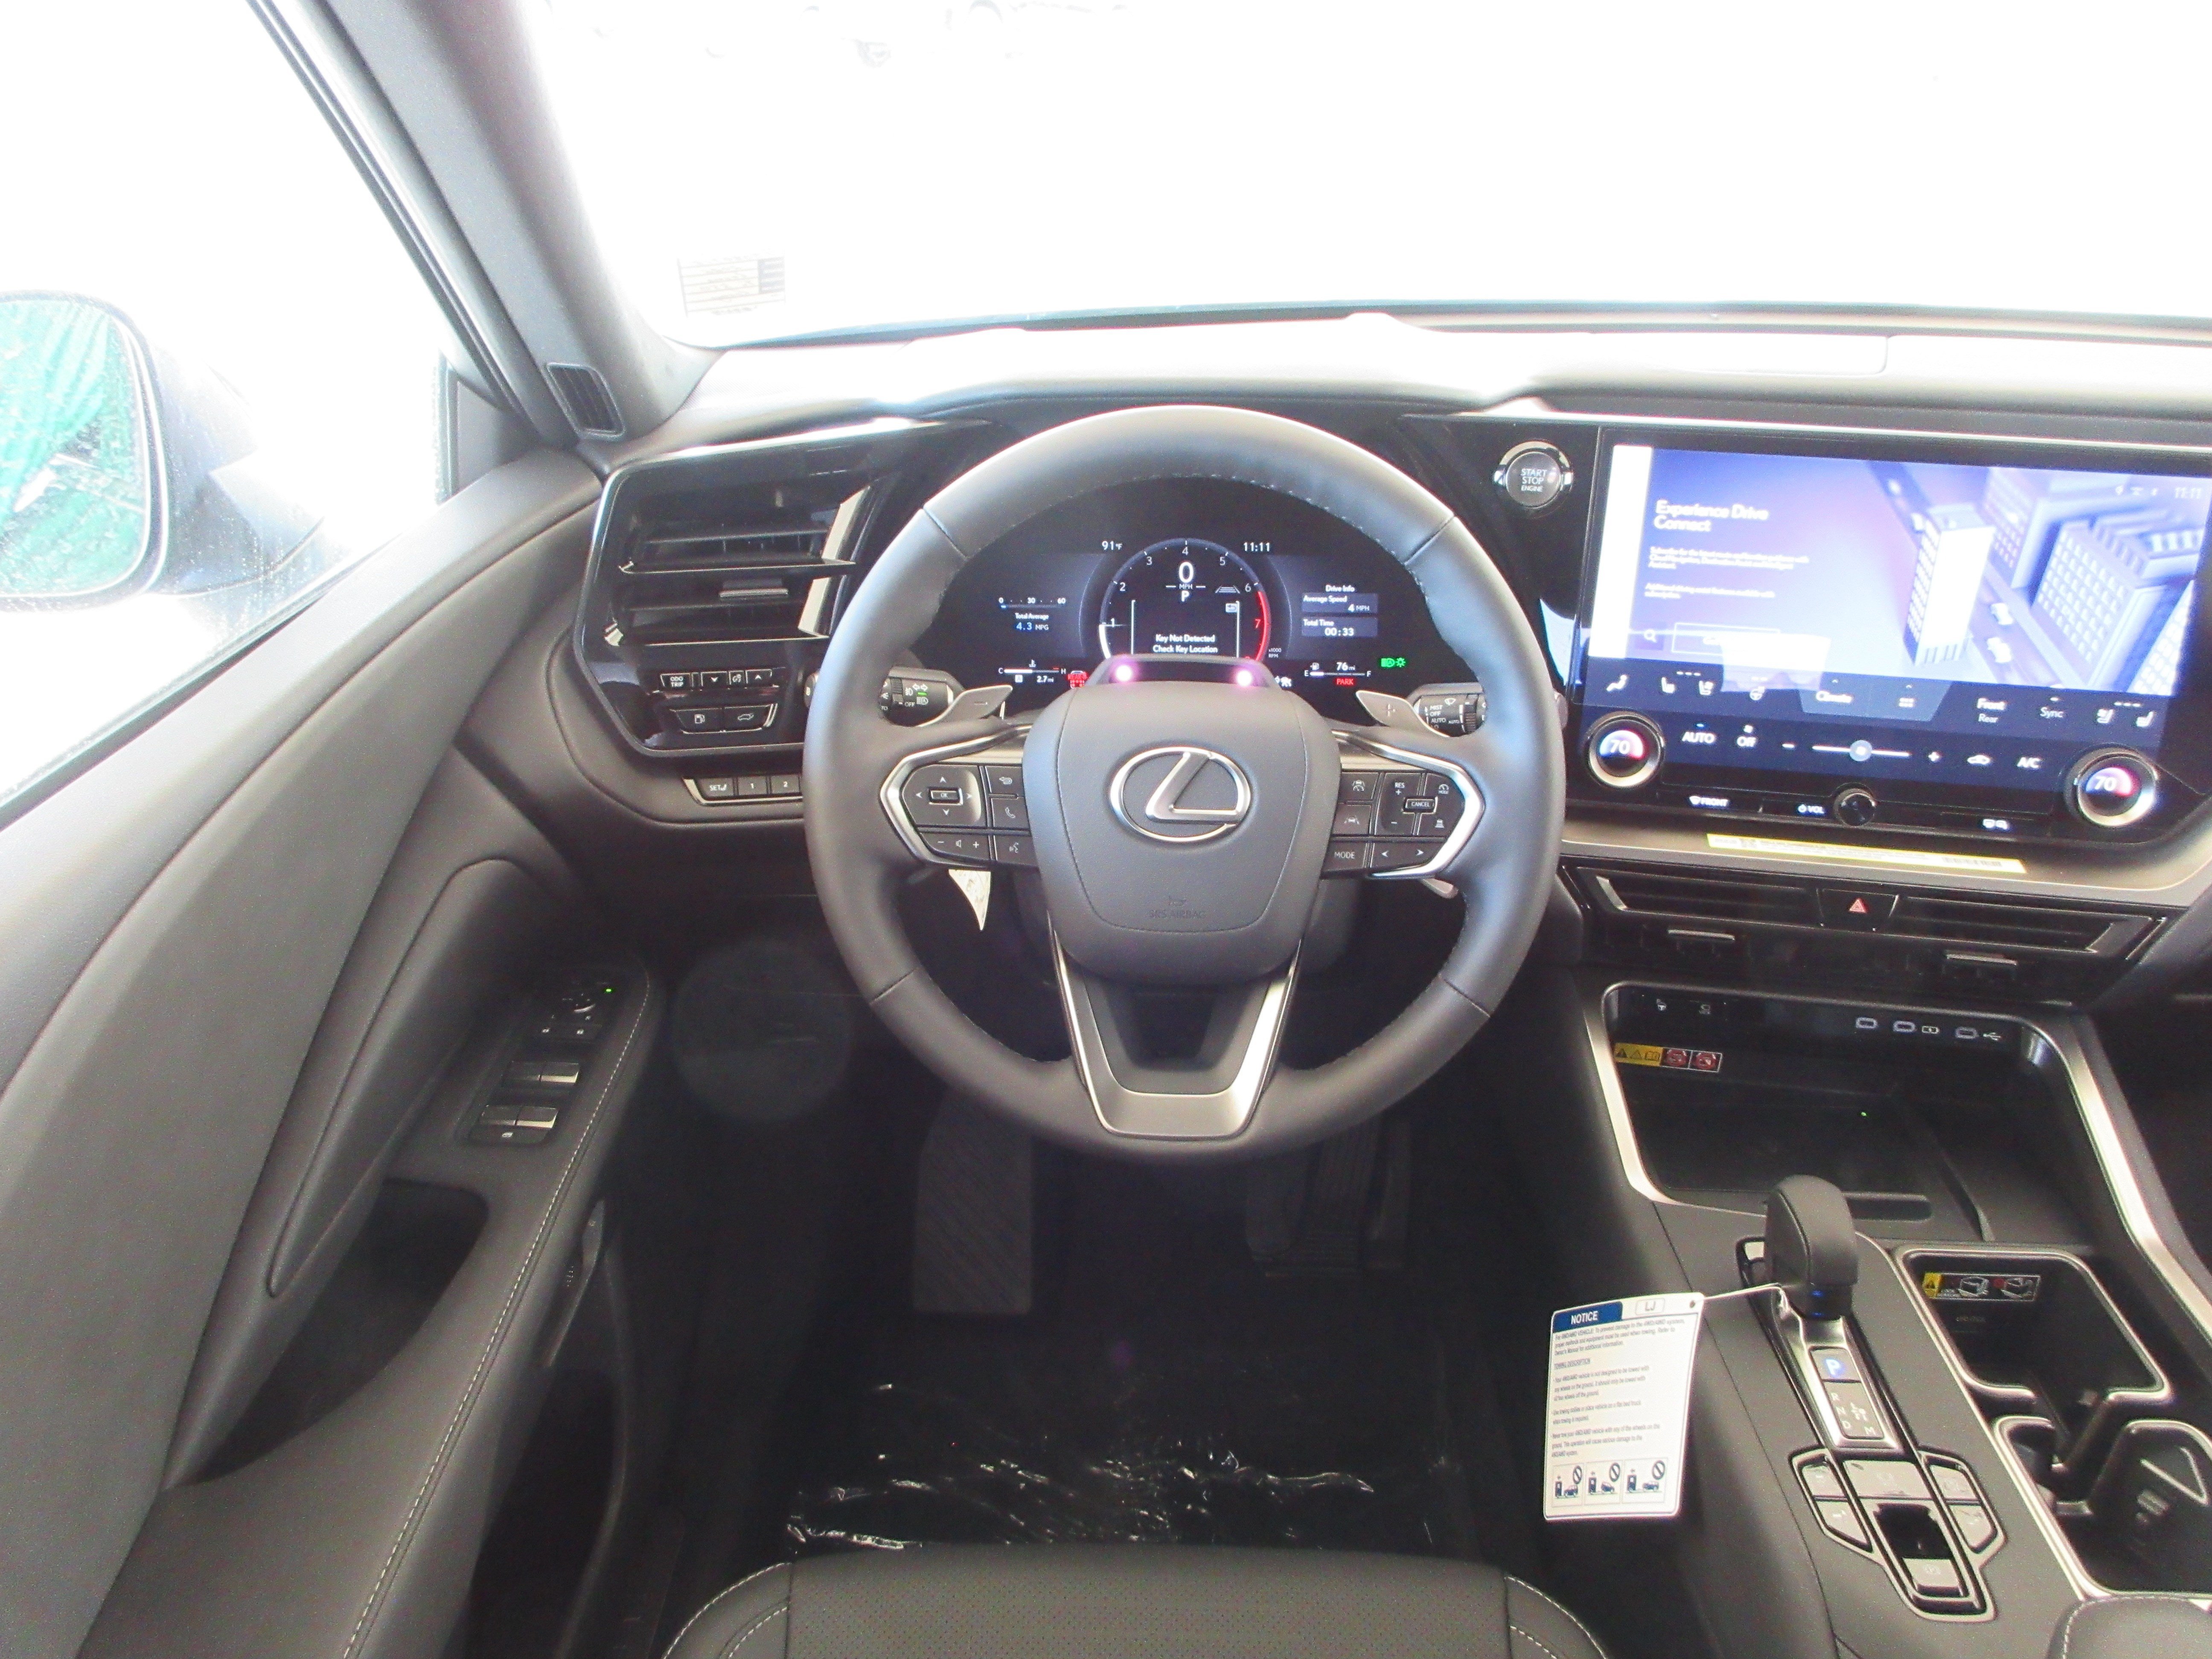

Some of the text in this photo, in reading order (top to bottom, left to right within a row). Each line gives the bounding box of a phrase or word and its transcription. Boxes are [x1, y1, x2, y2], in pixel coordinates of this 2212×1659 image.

[1656, 499, 1769, 520] Experience Drive
[1653, 515, 1711, 532] Connect
[1243, 542, 1270, 552] 11:11
[1146, 557, 1152, 565] 3
[1220, 557, 1225, 566] 5
[1179, 561, 1194, 583] 0
[1120, 582, 1126, 591] 2
[1245, 583, 1251, 592] 6
[1181, 591, 1190, 602] P
[1016, 622, 1032, 630] 4.3
[1110, 618, 1115, 627] 1
[1255, 619, 1261, 628] 7
[1324, 627, 1354, 636] 00:33
[1155, 634, 1168, 643] Key
[1175, 645, 1187, 653] Key
[1189, 645, 1218, 653] Location
[1976, 697, 2006, 710] Front
[2040, 707, 2064, 719] Sync
[1978, 713, 1999, 723] Rear
[1682, 731, 1716, 744] AUTO
[1610, 739, 1630, 754] 70
[2017, 757, 2042, 768] A/C
[2095, 776, 2116, 791] 70
[1701, 797, 1728, 807] FRONT
[1807, 806, 1824, 814] VOL
[1571, 1310, 1598, 1325] NOTICE
[1825, 1359, 1841, 1375] P
[1831, 1393, 1839, 1401] R
[1837, 1406, 1846, 1415] N
[1842, 1420, 1851, 1429] D
[1864, 1426, 1877, 1435] M
